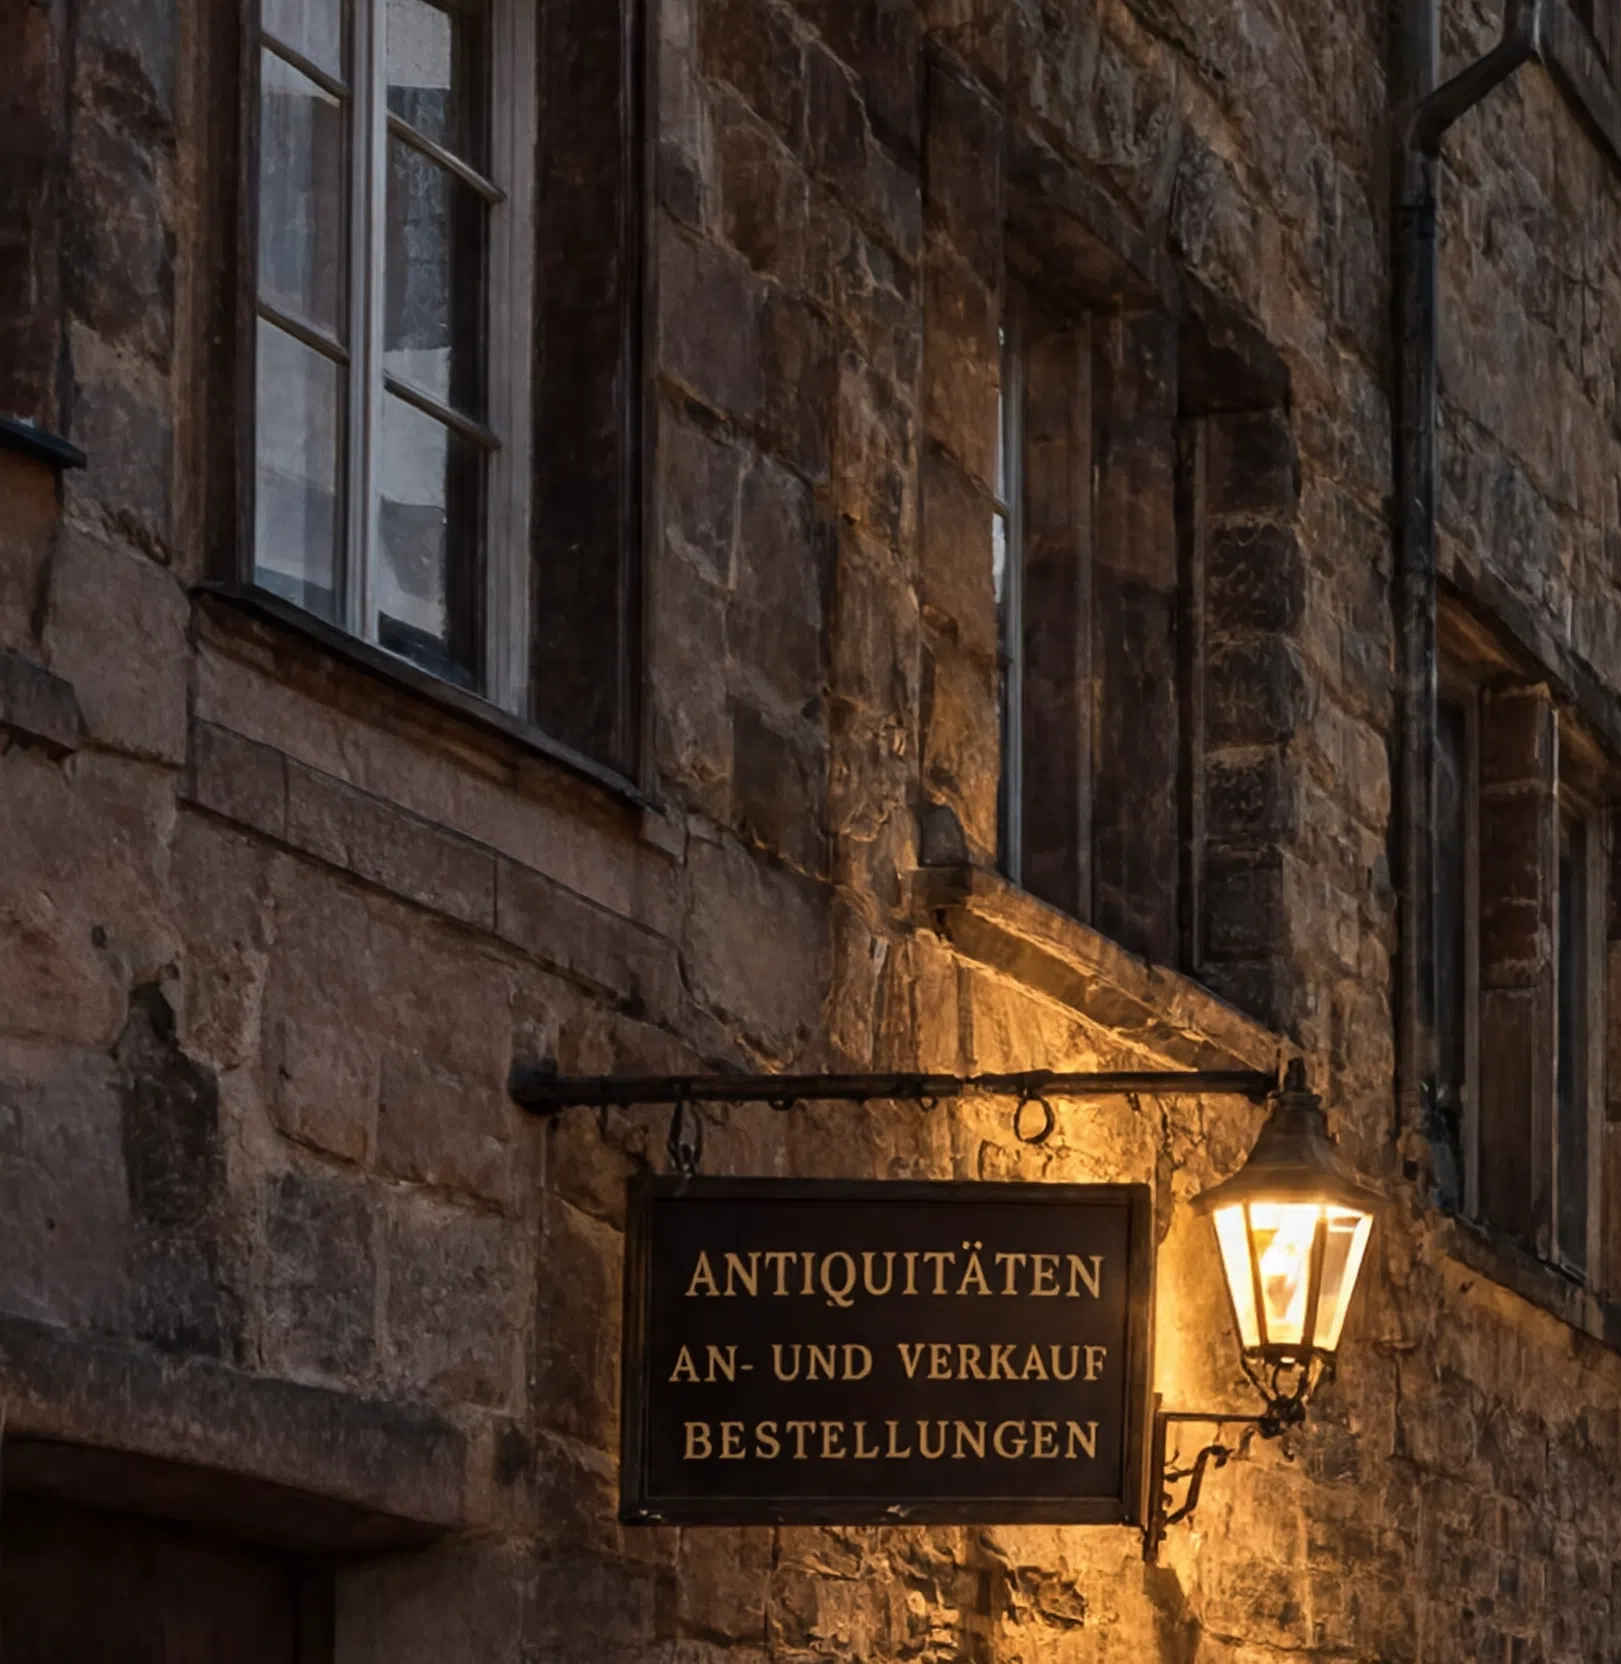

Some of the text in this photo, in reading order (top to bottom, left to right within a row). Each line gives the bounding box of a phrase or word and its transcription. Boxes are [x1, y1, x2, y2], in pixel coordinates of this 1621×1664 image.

[685, 1241, 1105, 1308] ANTIQUITÄTEN
[669, 1343, 1108, 1383] AN- UND VERKAUF
[684, 1420, 1100, 1459] BESTELLUNGEN
